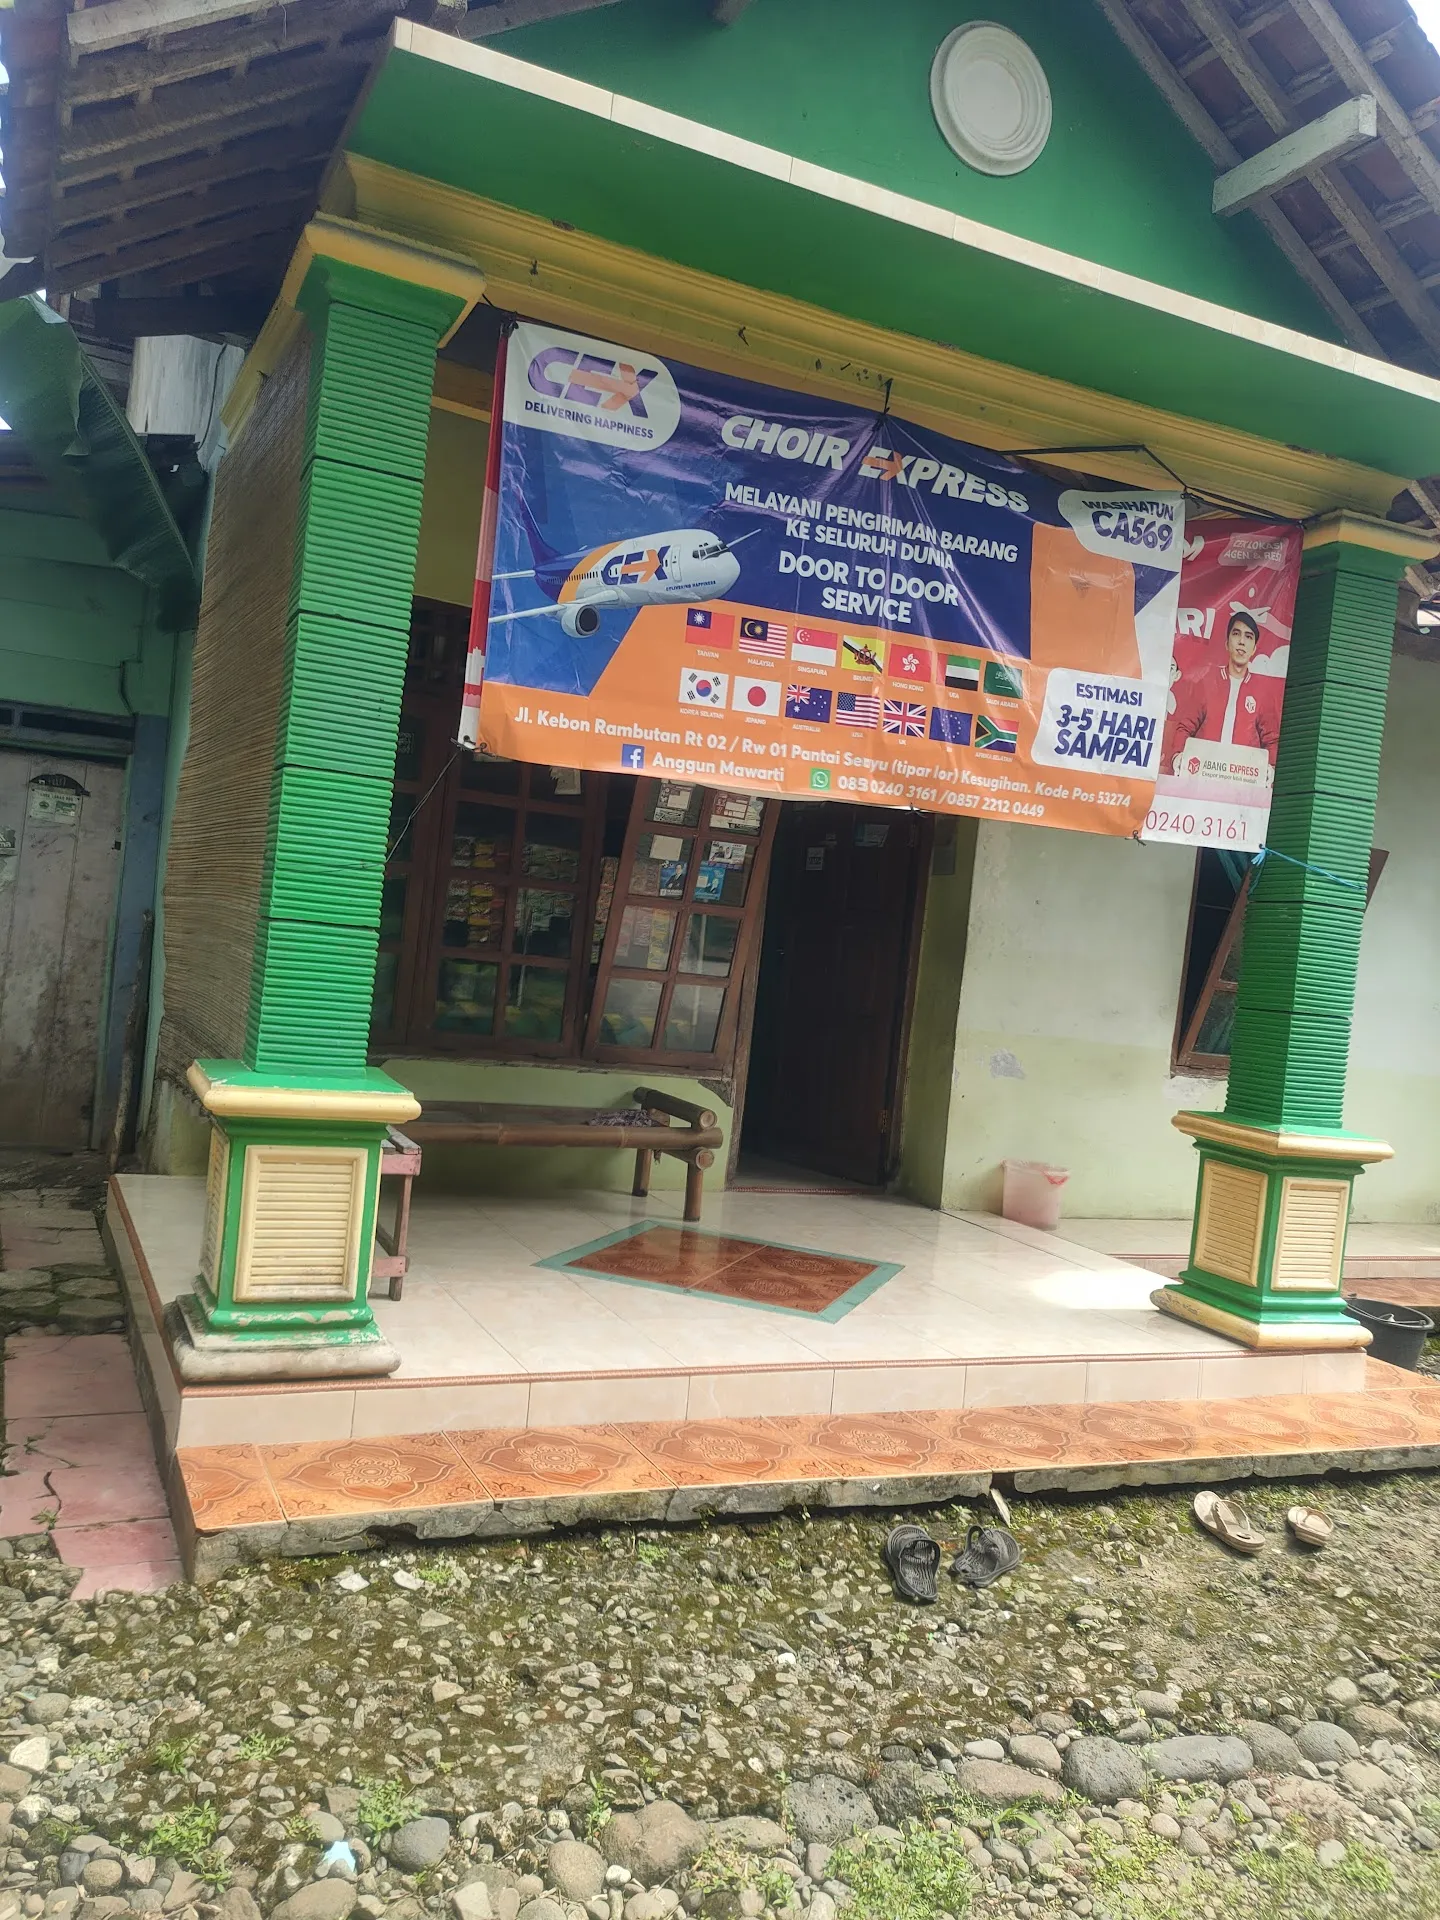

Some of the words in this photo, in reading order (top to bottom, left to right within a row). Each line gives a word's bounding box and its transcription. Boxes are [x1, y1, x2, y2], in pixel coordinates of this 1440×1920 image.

[528, 347, 658, 419] CEX
[524, 400, 592, 425] DELIVERING
[594, 417, 654, 439] HAPPINESS
[721, 415, 851, 471] CHOIR
[858, 446, 1031, 513] EXPRESS
[725, 482, 822, 520] MELAYANI
[825, 502, 938, 545] PENGIRIMAN
[940, 530, 1019, 563] BARANG
[1081, 500, 1174, 522] WASIHATUN
[786, 519, 811, 541] KE
[815, 524, 897, 558] SELURUH
[900, 541, 954, 572] DUNIA
[1091, 510, 1174, 551] CA569
[601, 545, 671, 586] CEX
[1223, 549, 1250, 560] AGEN
[778, 550, 850, 585] DOOR
[855, 566, 886, 591] TO
[890, 573, 959, 607] DOOR
[820, 587, 912, 624] SERVICE
[1175, 607, 1216, 640] RI
[696, 649, 720, 660] TAIWAN
[747, 657, 775, 668] MALAYSIA
[797, 665, 828, 676] SINGAPURA
[892, 681, 908, 690] HONG
[1075, 682, 1143, 707] ESTIMASI
[679, 707, 698, 718] KOREA
[1055, 703, 1094, 731] 3-5
[1098, 710, 1157, 742] HARI
[537, 709, 590, 733] Kebon
[595, 715, 680, 745] Rambutan
[684, 730, 703, 747] Rt
[706, 733, 727, 751] 02
[729, 735, 740, 752] /
[741, 737, 767, 755] Rw
[770, 742, 787, 758] 01
[791, 743, 840, 765] Pantai
[891, 758, 931, 778] (tipar
[932, 764, 958, 784] lor)
[961, 765, 1031, 794] Kesugihan.
[1034, 780, 1069, 800] Kode
[1071, 787, 1096, 804] Pos
[1097, 790, 1131, 808] 53274
[1053, 728, 1154, 769] SAMPAI
[652, 752, 716, 777] Anggun
[719, 760, 785, 783] Mawarti
[1203, 759, 1227, 772] ABANG
[1229, 763, 1260, 777] EXPRESS
[870, 779, 904, 797] 0240
[906, 785, 937, 801] 3161
[982, 793, 1010, 813] 2212
[1012, 798, 1045, 818] 0449
[1145, 809, 1195, 835] 0240
[1201, 816, 1247, 841] 3161
